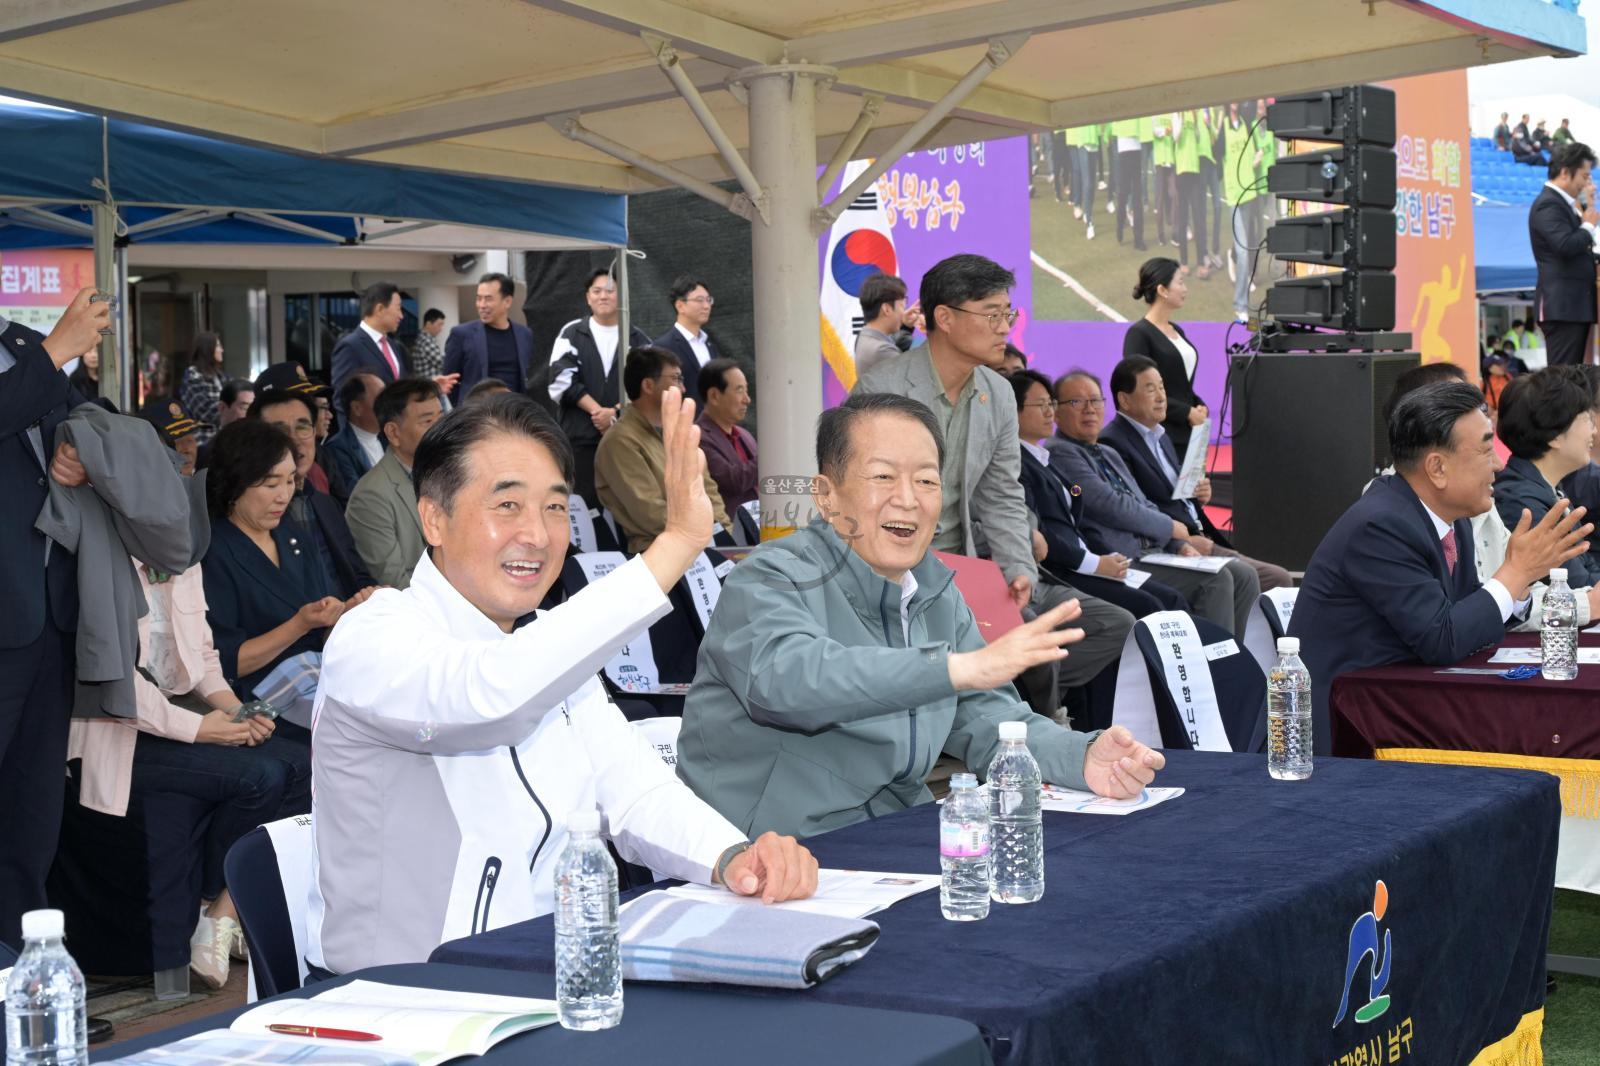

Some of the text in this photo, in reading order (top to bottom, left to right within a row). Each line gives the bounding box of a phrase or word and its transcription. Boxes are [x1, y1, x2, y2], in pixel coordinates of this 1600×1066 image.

[1426, 191, 1456, 240] 남구
[1, 265, 61, 294] 집계표
[657, 743, 673, 755] 구민
[1388, 1016, 1413, 1063] 남구
